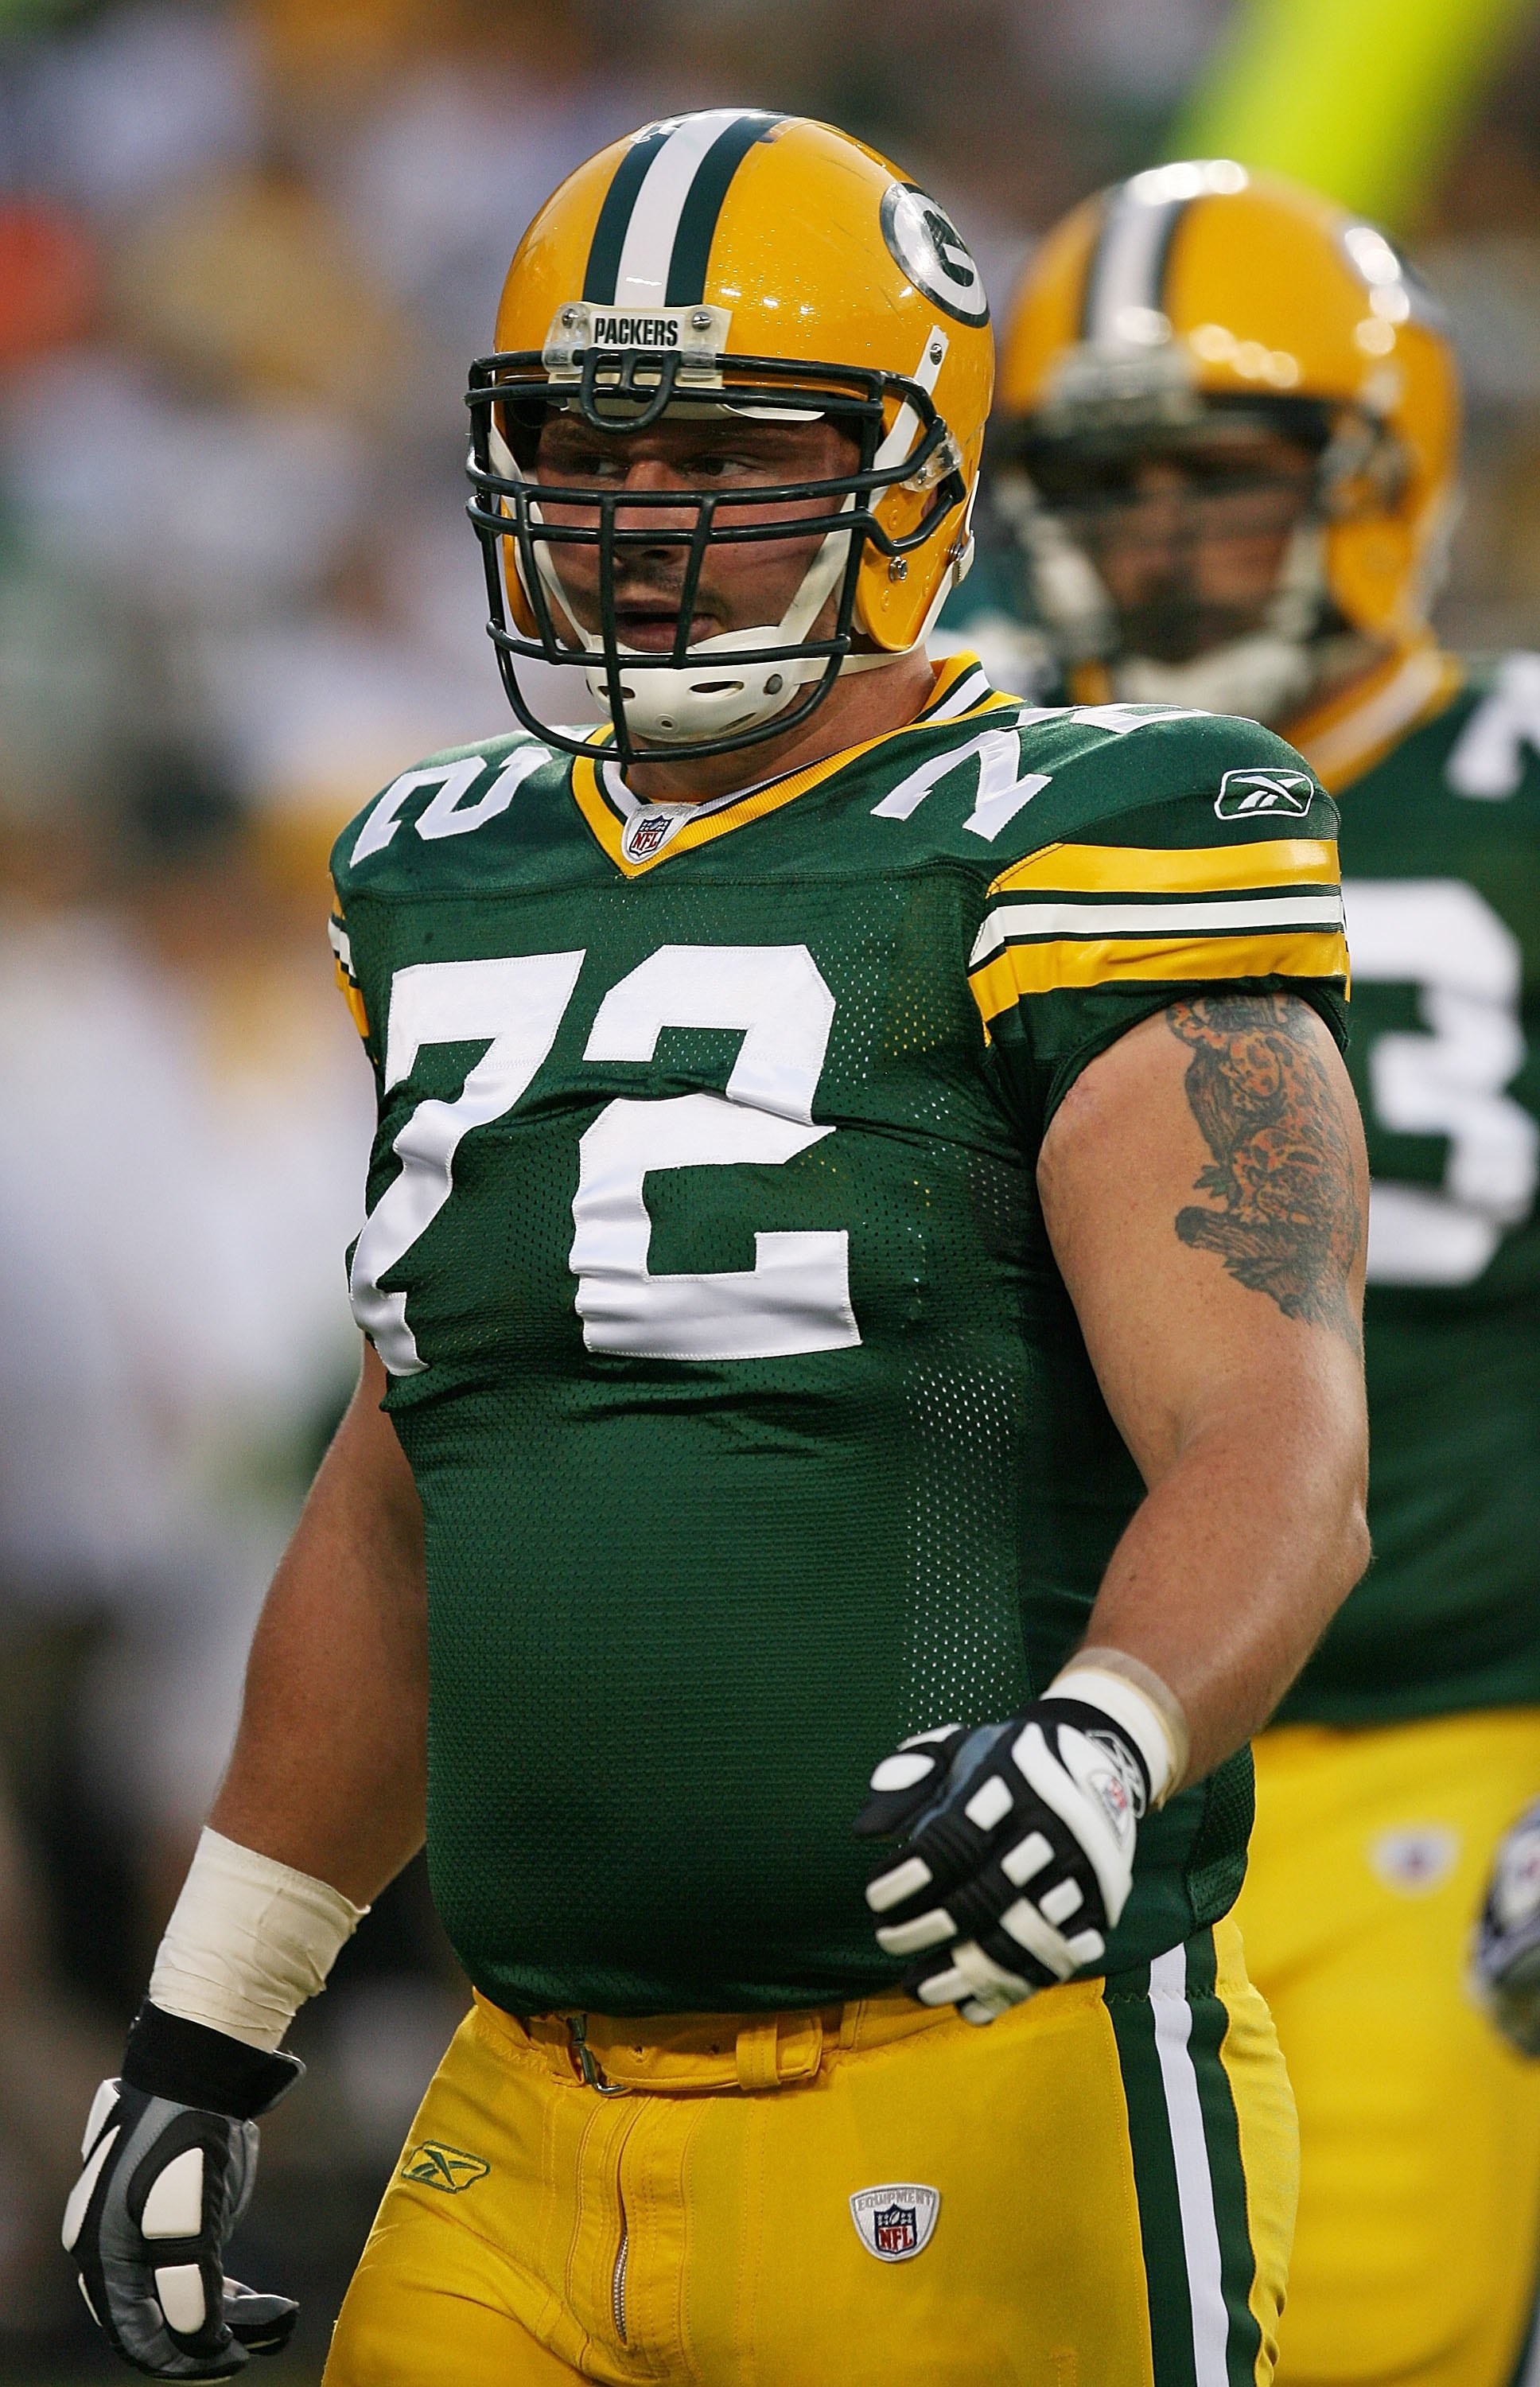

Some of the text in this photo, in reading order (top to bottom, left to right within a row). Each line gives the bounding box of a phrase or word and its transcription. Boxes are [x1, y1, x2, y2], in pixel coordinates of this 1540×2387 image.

[594, 317, 679, 347] PACKERS
[632, 831, 659, 851] NFL
[351, 944, 862, 1376] 72
[879, 2226, 914, 2250] NFL
